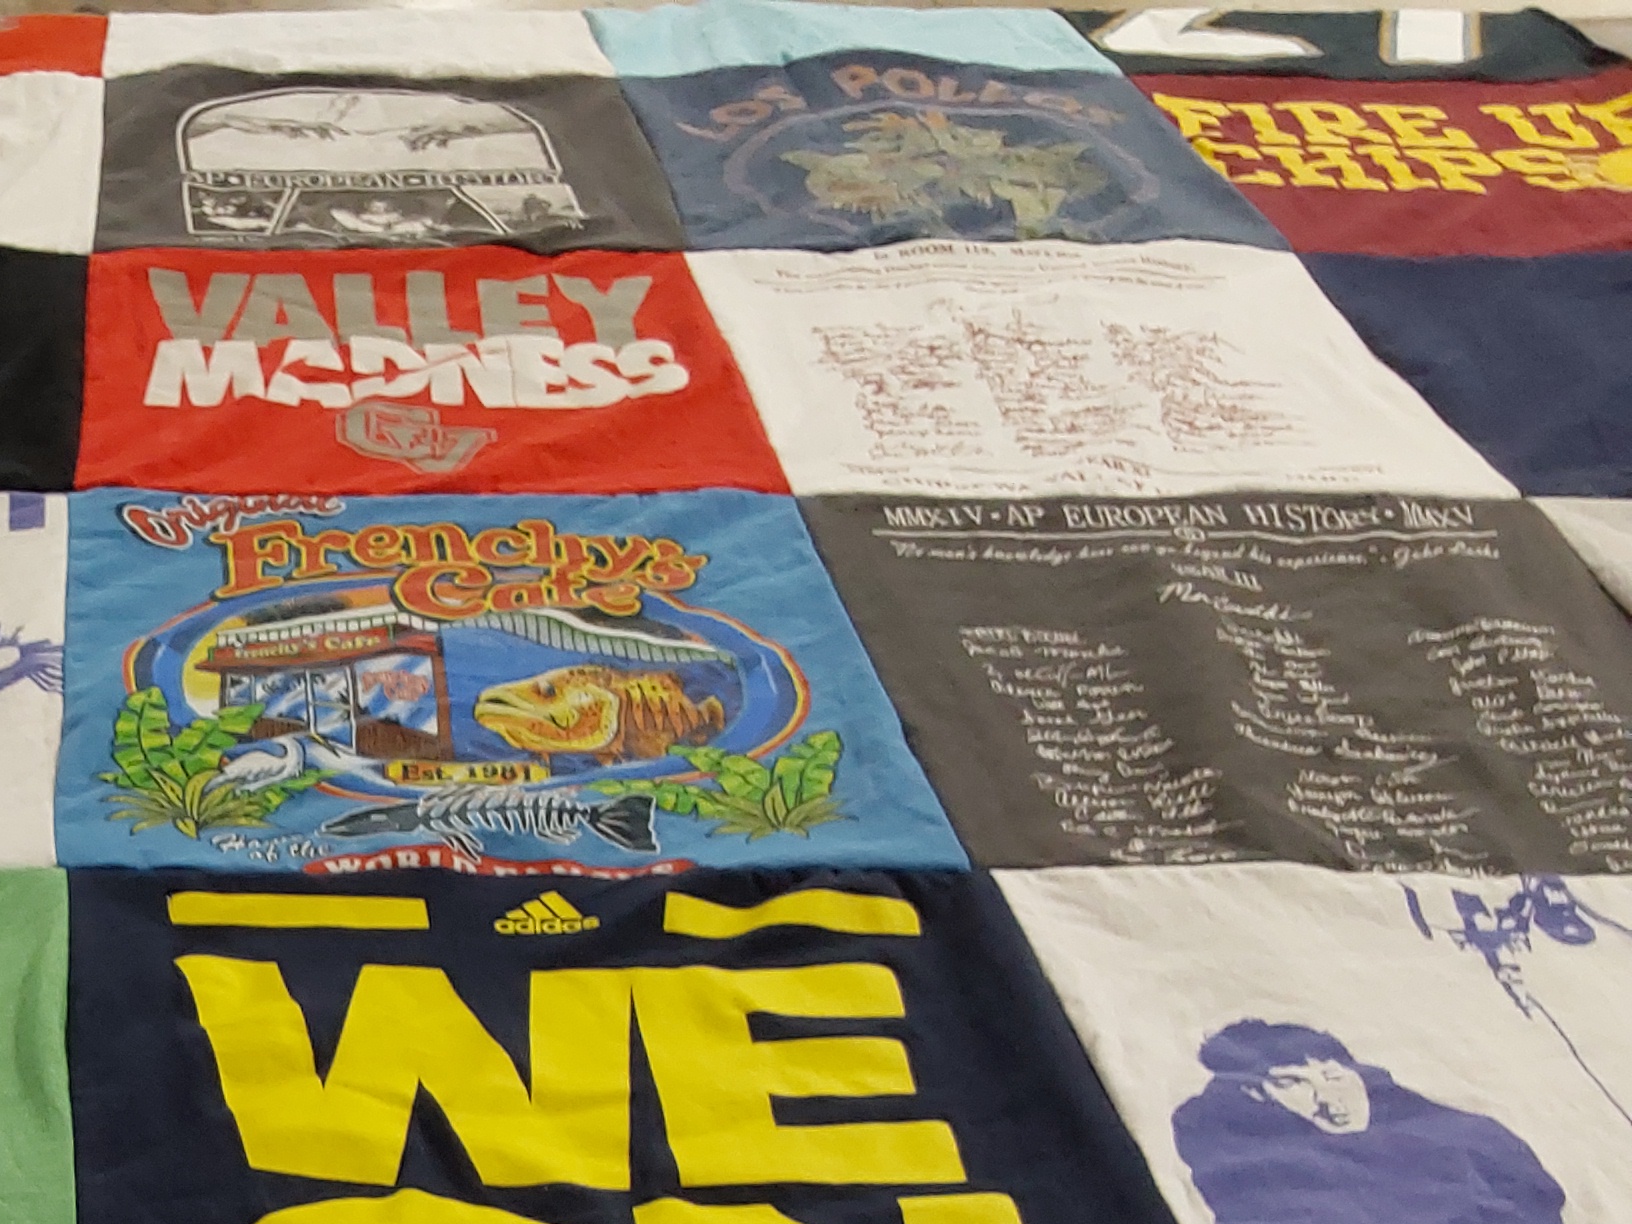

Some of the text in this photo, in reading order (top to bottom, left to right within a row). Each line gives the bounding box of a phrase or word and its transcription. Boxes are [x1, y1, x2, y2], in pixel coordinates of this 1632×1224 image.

[1152, 93, 1478, 149] FIRE
[1190, 136, 1593, 195] CHIPS
[148, 268, 654, 348] VALLEY
[143, 334, 691, 409] MADNESS
[882, 504, 983, 528] MMXIV
[1006, 503, 1046, 527] AP
[1063, 502, 1227, 529] EUROPEAN
[1243, 502, 1380, 532] HISTORY
[210, 519, 709, 601] Frenchy's
[393, 560, 647, 620] Cafe
[464, 761, 533, 783] 1981
[493, 915, 601, 935] adidas
[172, 955, 968, 1190] WE
